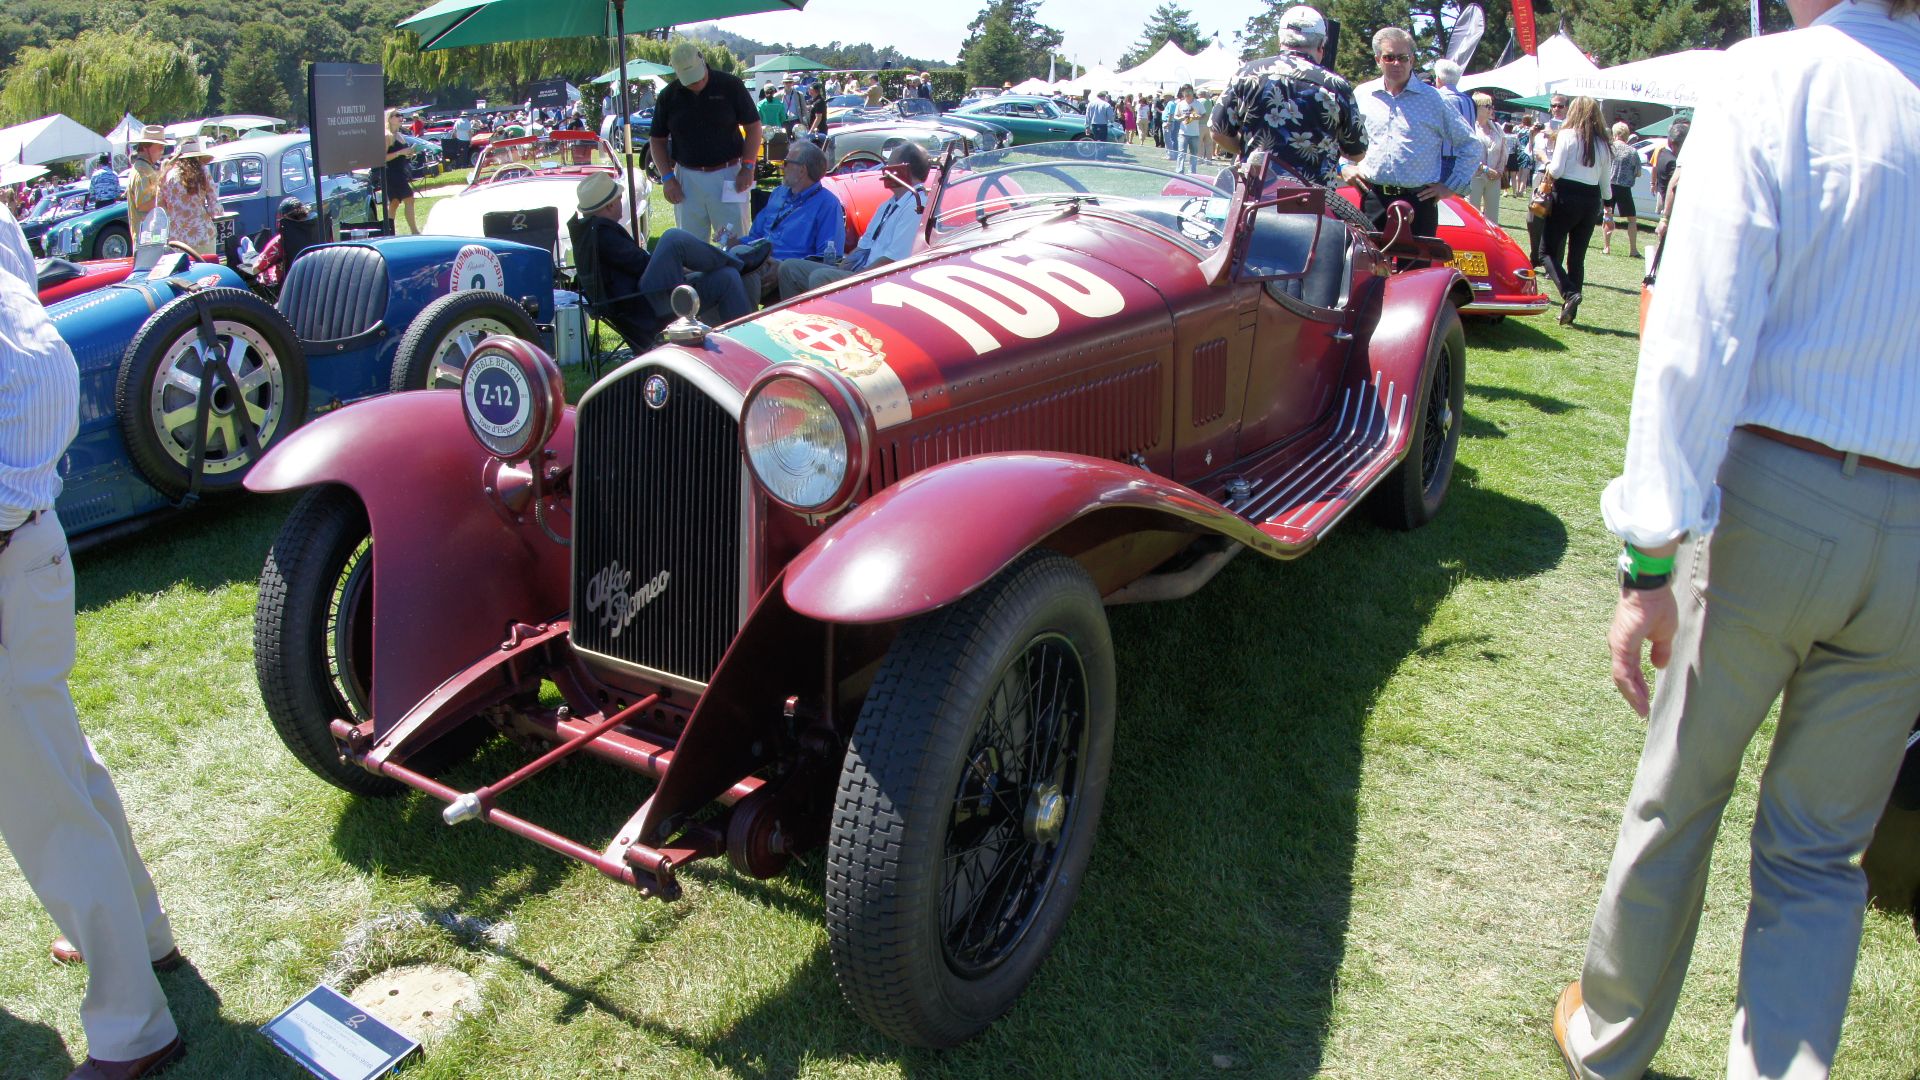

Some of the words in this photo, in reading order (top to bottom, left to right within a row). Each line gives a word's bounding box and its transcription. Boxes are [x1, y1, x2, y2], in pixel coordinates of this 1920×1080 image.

[452, 248, 474, 291] ALIFORNIA
[871, 242, 1126, 355] 106
[470, 357, 494, 381] PEBBLE
[495, 357, 521, 383] BEACH
[480, 384, 513, 407] Z-12
[585, 559, 632, 628] Alfa
[608, 569, 671, 638] Romeo
